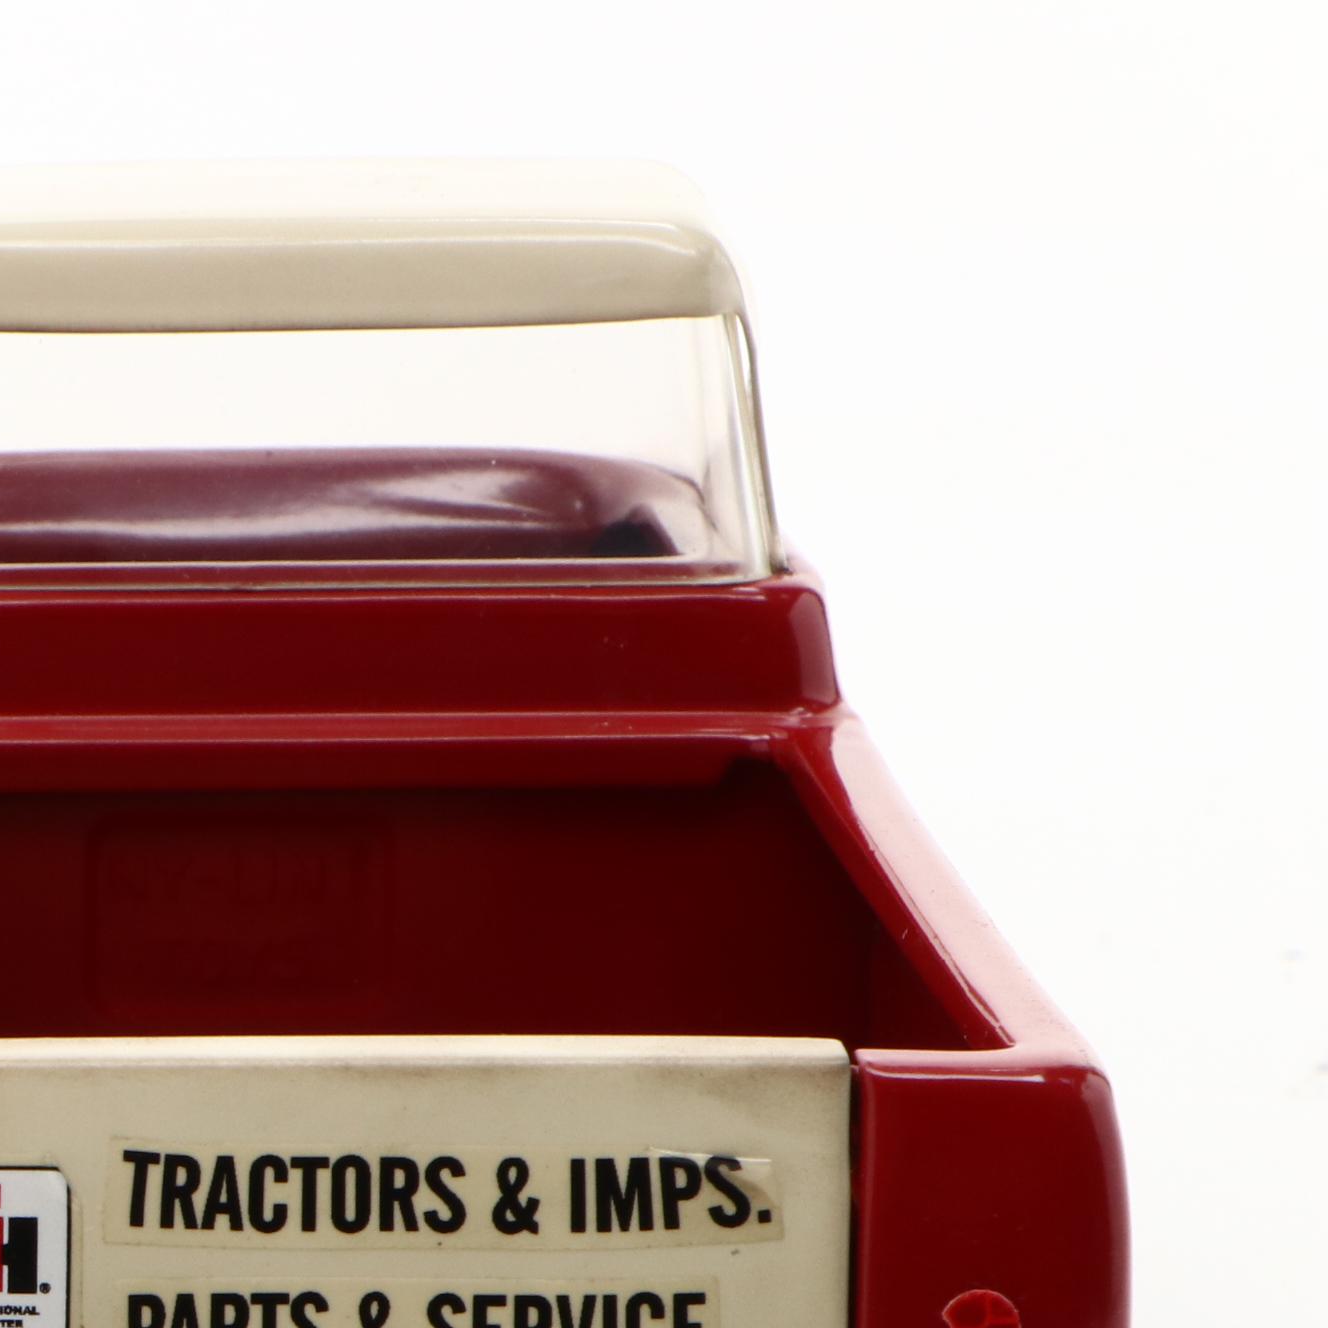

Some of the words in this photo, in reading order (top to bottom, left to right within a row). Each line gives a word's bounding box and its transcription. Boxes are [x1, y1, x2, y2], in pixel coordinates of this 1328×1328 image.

[123, 1149, 467, 1234] TRACTORS
[491, 1157, 540, 1235] &
[570, 1155, 772, 1233] IMPS.
